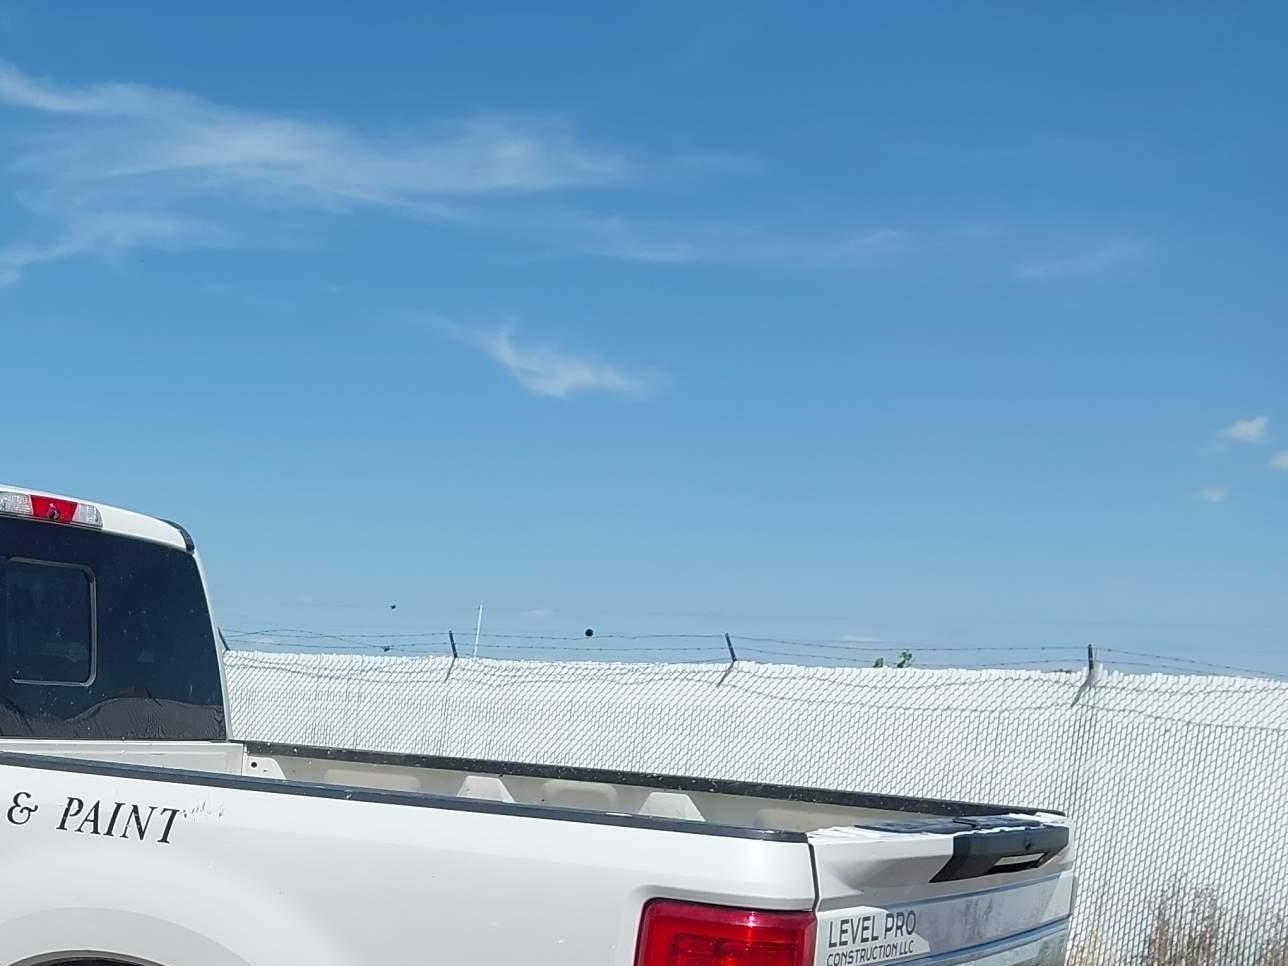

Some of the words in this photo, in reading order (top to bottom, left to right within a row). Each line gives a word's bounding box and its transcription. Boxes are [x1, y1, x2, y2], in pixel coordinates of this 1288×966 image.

[7, 791, 39, 824] &
[56, 796, 181, 844] PAINT
[828, 915, 879, 948] LEVEL
[884, 910, 916, 939] PRO
[899, 939, 914, 956] LLC
